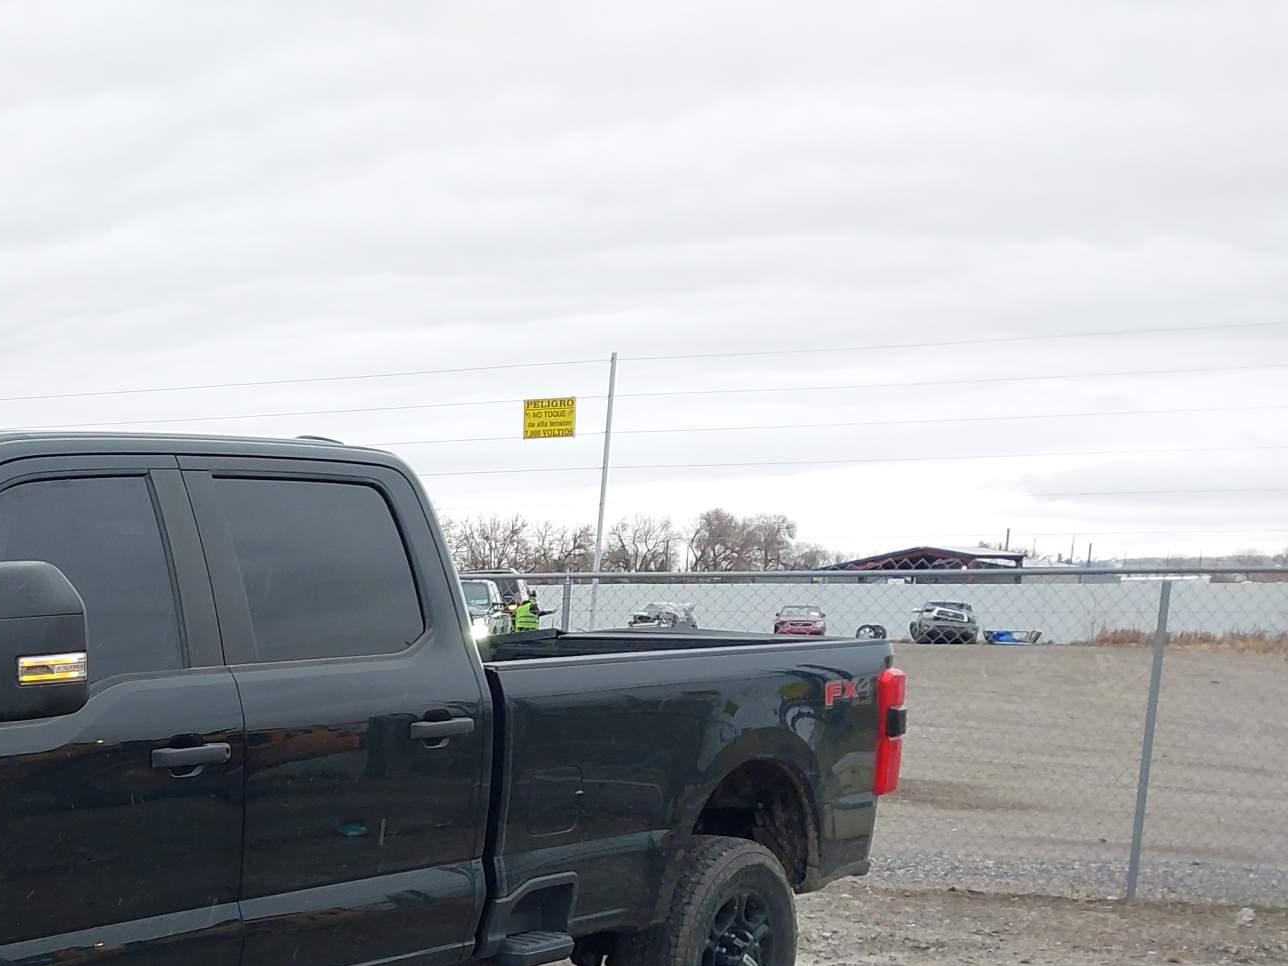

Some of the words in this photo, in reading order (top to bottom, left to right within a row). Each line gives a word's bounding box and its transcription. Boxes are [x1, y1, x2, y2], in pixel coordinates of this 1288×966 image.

[526, 399, 574, 409] PELIGRO
[532, 411, 543, 419] NO
[824, 678, 873, 705] FX4
